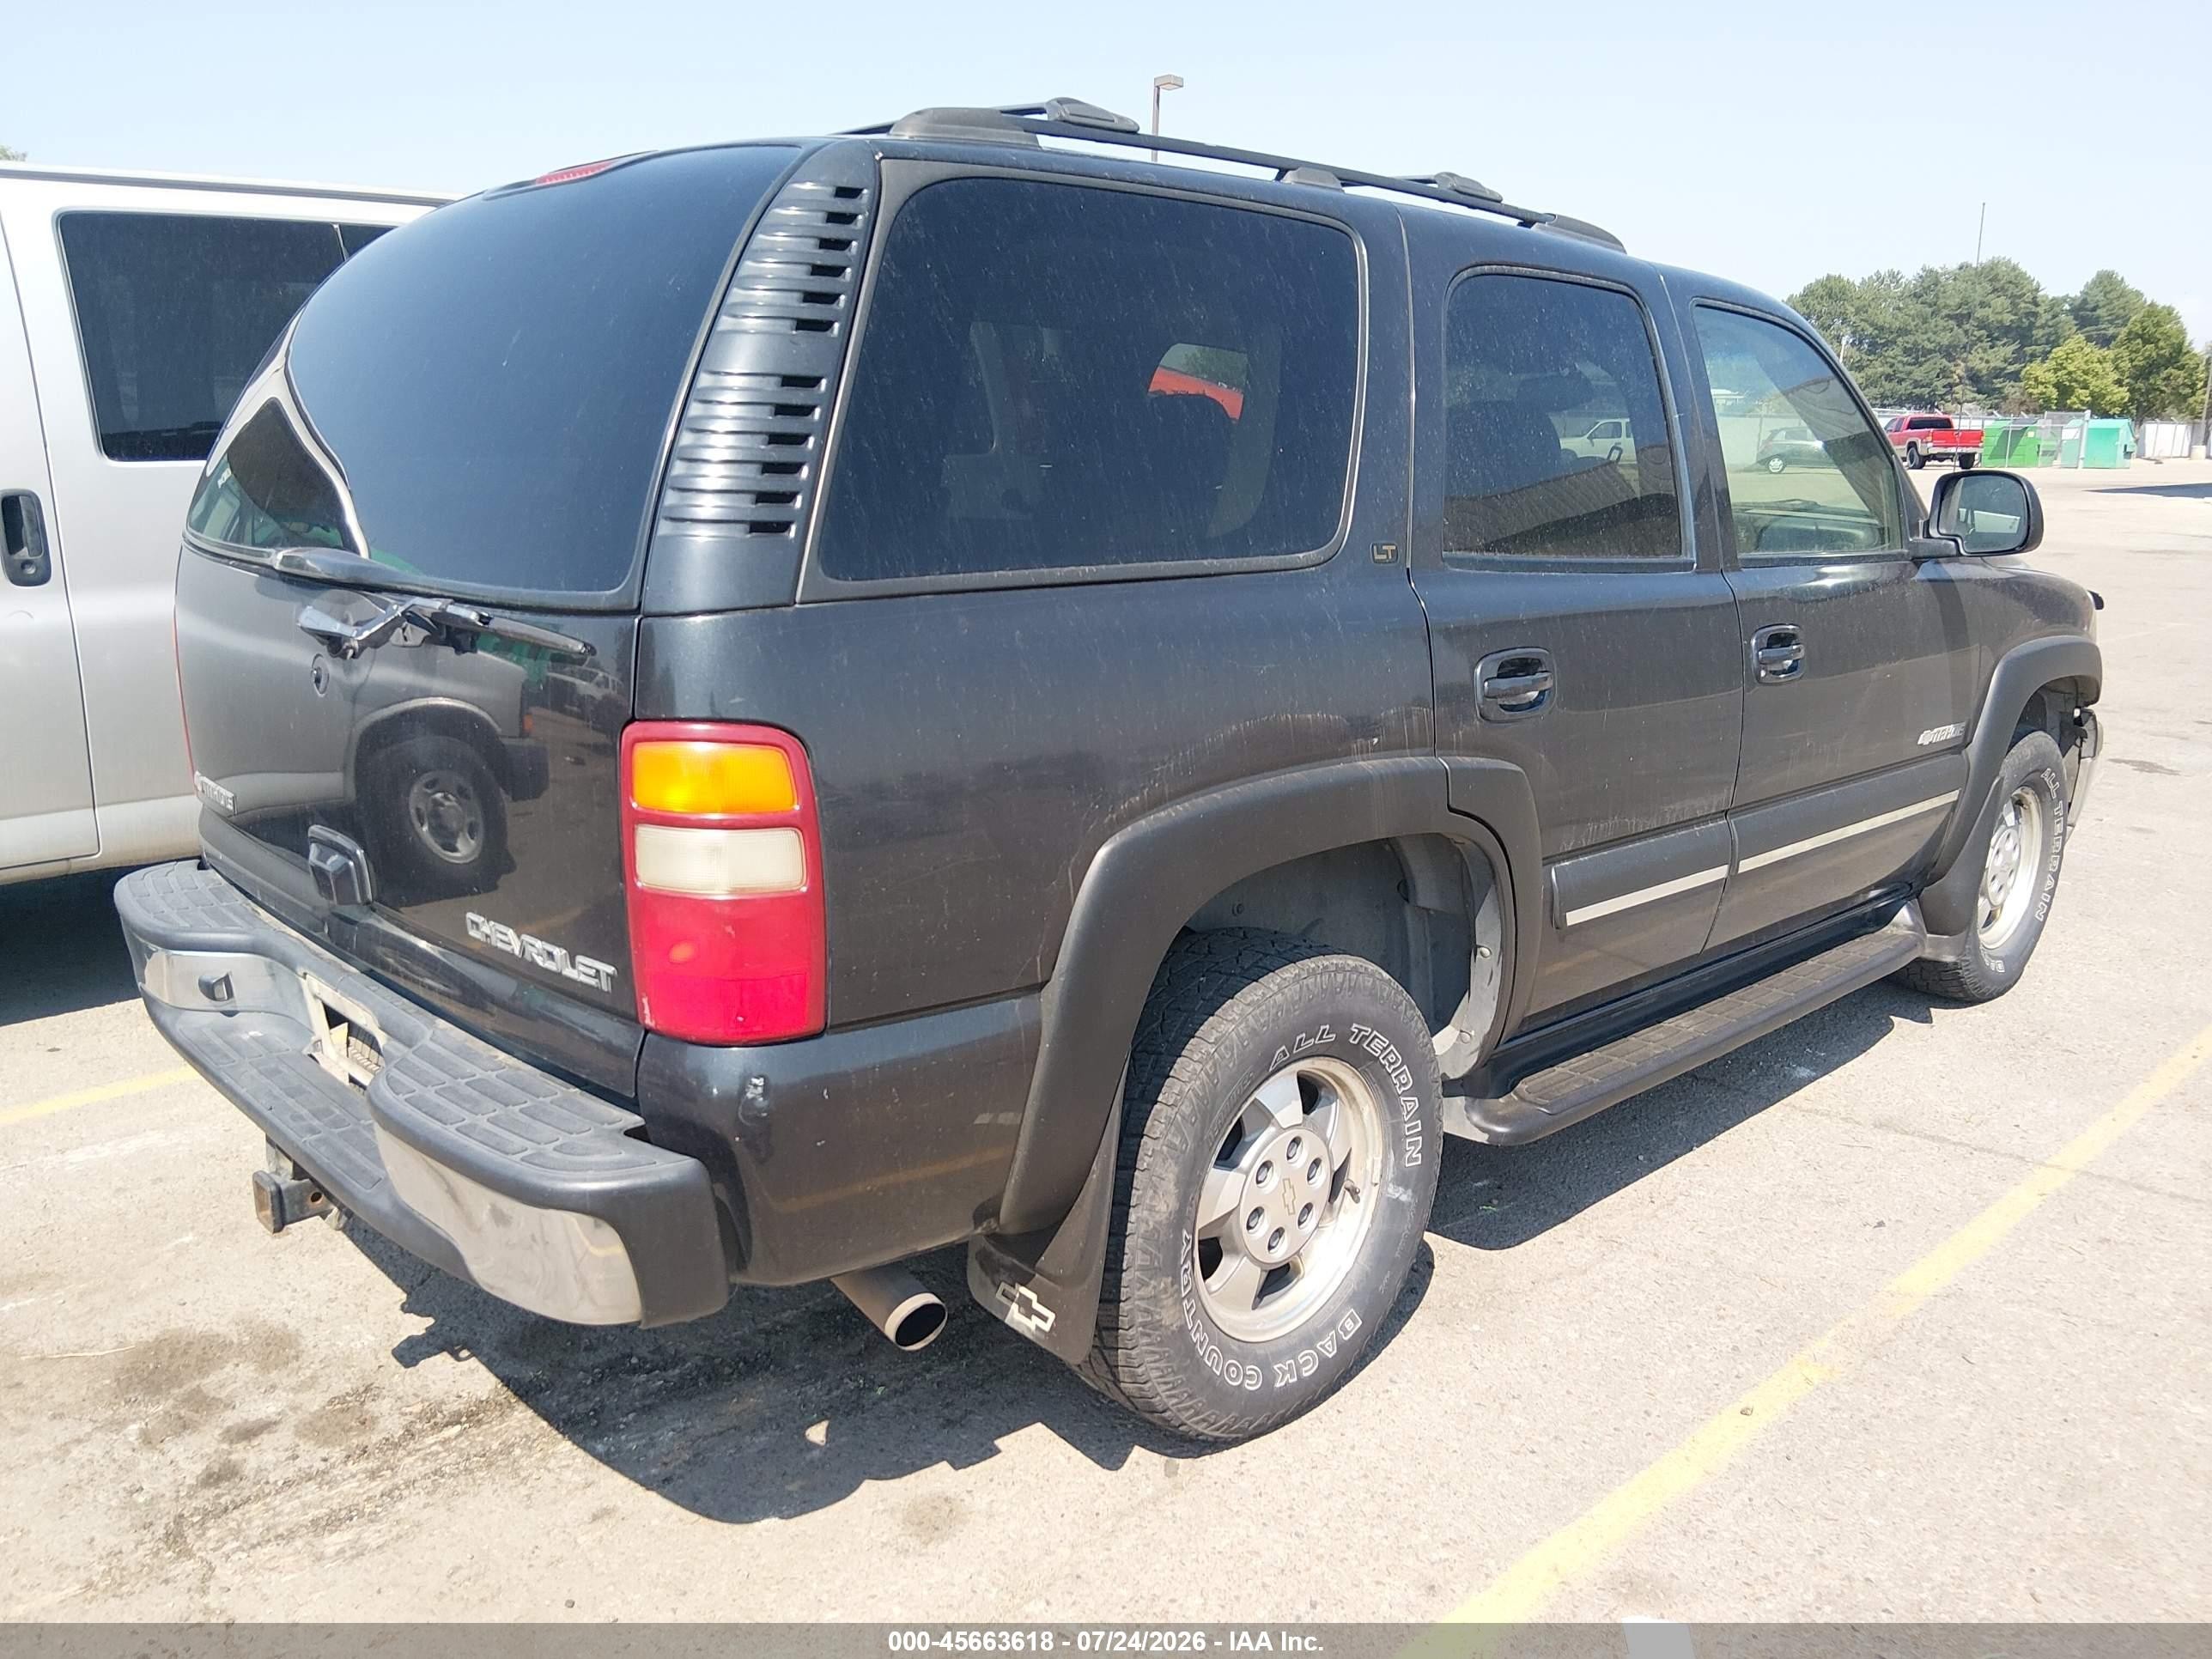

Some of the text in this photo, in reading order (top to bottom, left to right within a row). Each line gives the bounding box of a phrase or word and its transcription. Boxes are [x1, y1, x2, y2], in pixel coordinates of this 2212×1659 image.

[1373, 544, 1397, 560] LT
[2034, 768, 2064, 922] ALL TERRAIN
[465, 911, 619, 994] CHEVROLET
[1268, 1024, 1337, 1073] ALL
[1348, 1022, 1424, 1168] TERRAIN
[1180, 1228, 1263, 1391] COUNTRY
[1273, 1307, 1363, 1389] BACK
